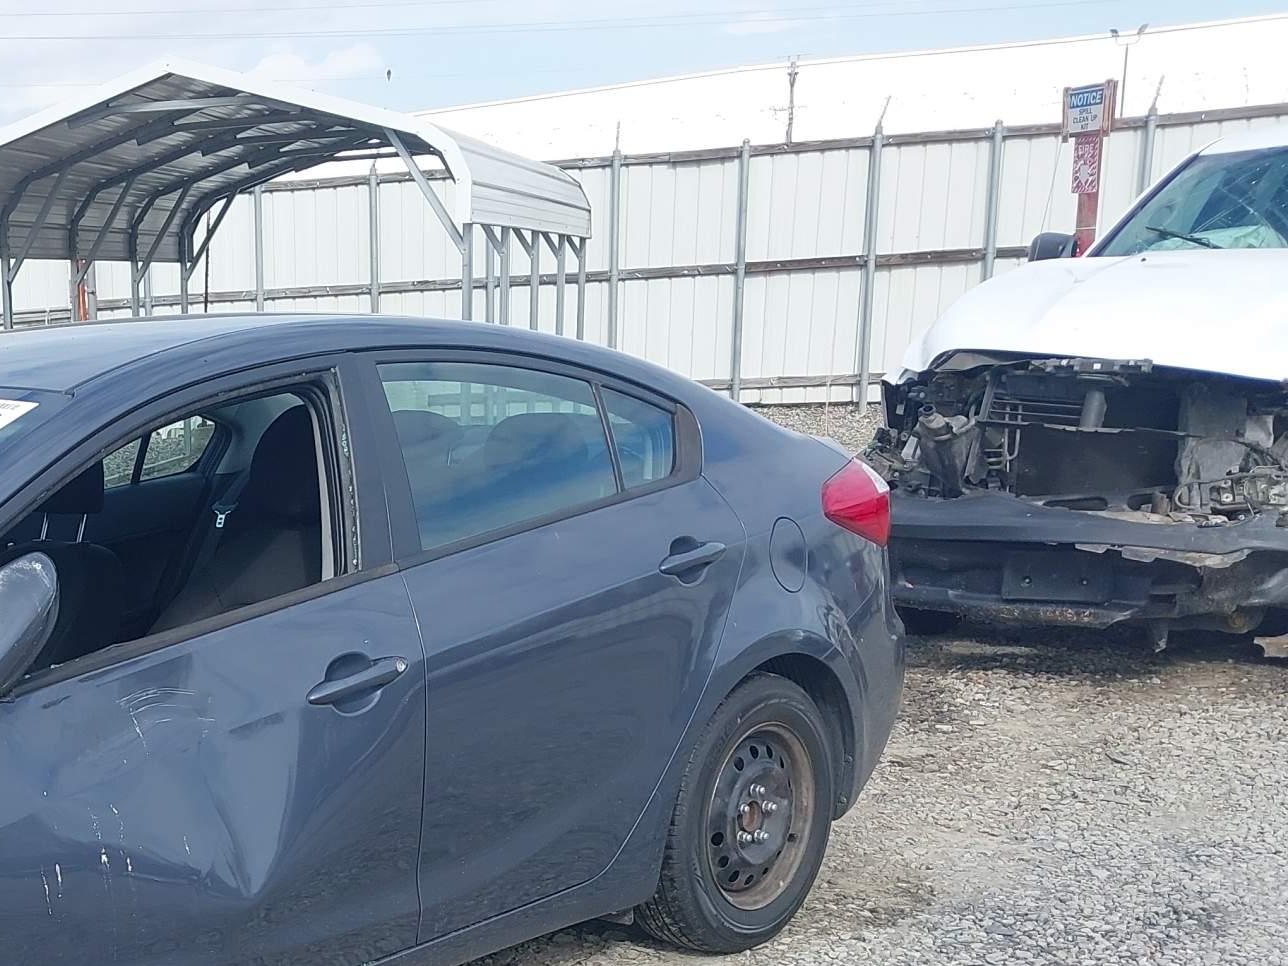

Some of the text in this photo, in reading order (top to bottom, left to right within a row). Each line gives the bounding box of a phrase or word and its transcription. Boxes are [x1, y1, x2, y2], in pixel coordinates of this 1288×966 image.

[1070, 91, 1103, 107] NOTICE
[1072, 114, 1098, 124] CLEAN UP
[1080, 122, 1089, 130] KIT
[1078, 143, 1095, 153] FIRE
